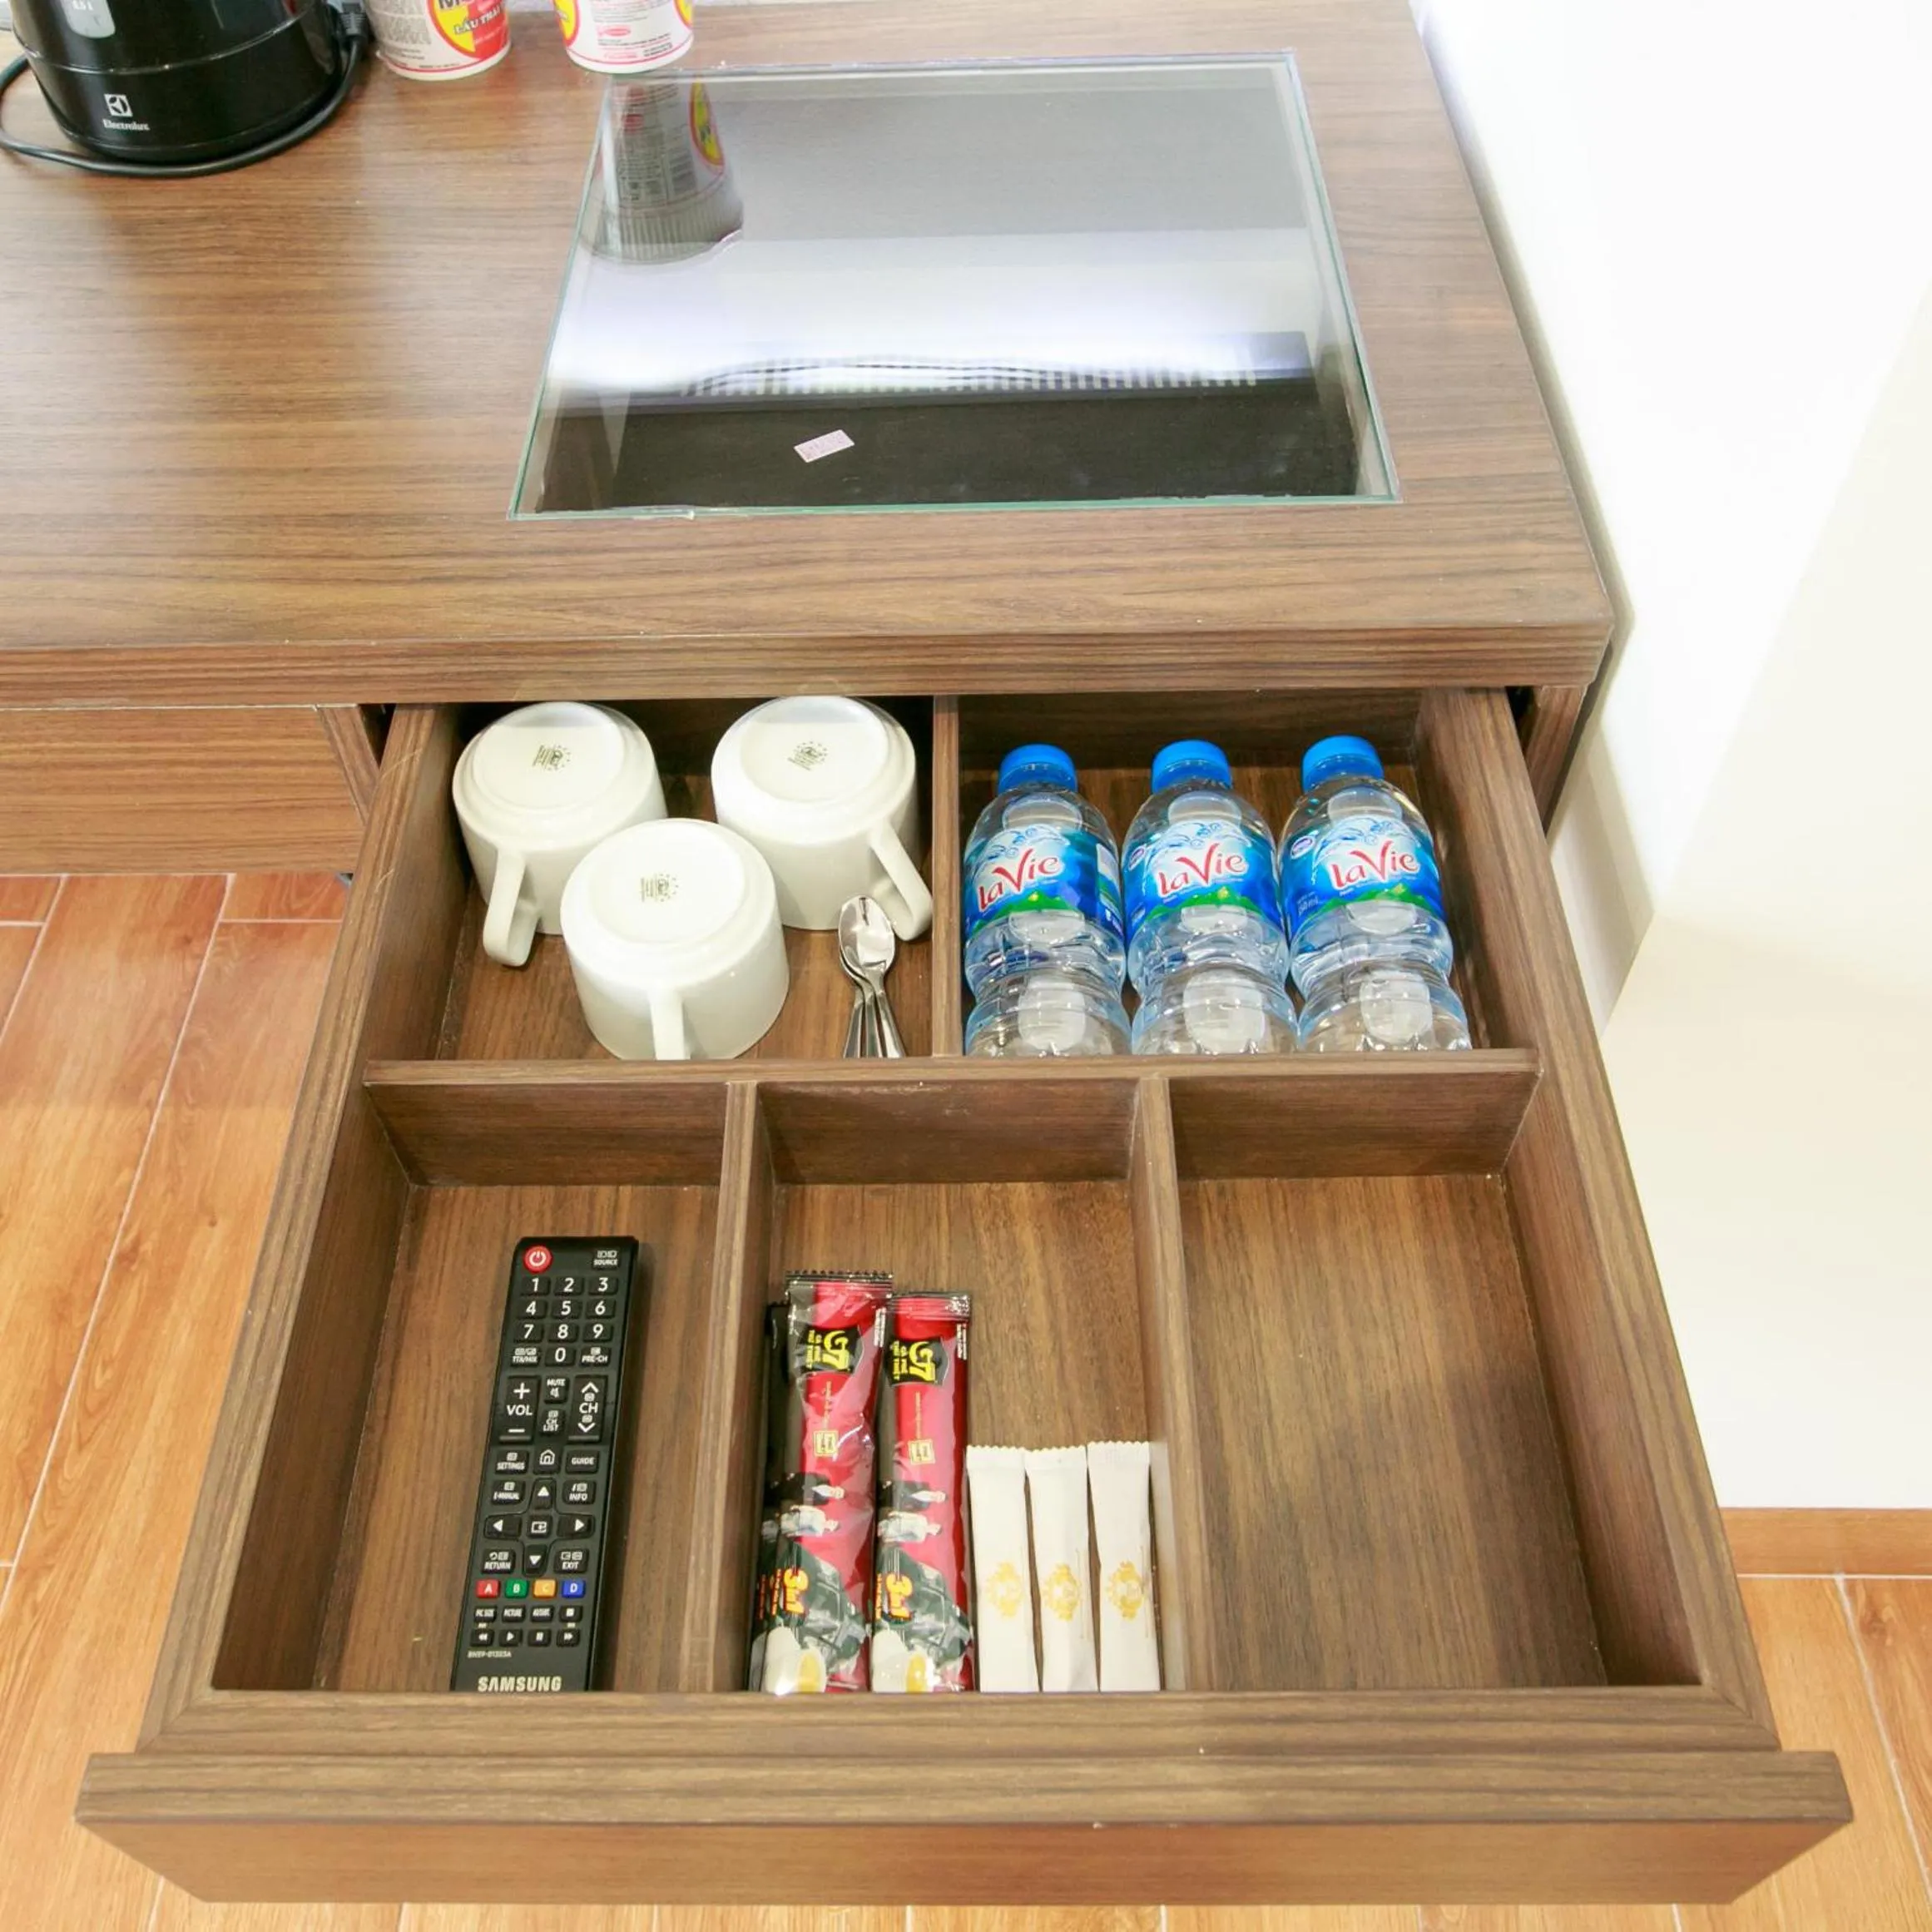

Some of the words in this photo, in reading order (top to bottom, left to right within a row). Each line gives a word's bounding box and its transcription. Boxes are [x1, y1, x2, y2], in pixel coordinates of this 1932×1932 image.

[103, 119, 151, 131] Electrolux
[532, 1278, 539, 1291] 1
[563, 1278, 574, 1291] 2
[598, 1278, 608, 1291] 3
[525, 1301, 537, 1315] 4
[561, 1301, 572, 1315] 5
[595, 1301, 606, 1315] 6
[524, 1324, 534, 1339] 7
[557, 1324, 568, 1339] 8
[592, 1324, 603, 1339] 9
[555, 1347, 566, 1363] 0
[824, 1330, 850, 1370] G7
[909, 1341, 936, 1381] G7
[547, 1379, 566, 1387] MUTE
[507, 1404, 533, 1415] VOL
[579, 1403, 598, 1414] CH
[497, 1462, 525, 1470] SETTINGS
[572, 1457, 595, 1465] GUIDE
[484, 1562, 511, 1570] RETURN
[562, 1562, 578, 1570] EXIT
[484, 1584, 493, 1593] A
[513, 1584, 520, 1593] B
[542, 1584, 549, 1593] C
[570, 1584, 577, 1593] D
[478, 1676, 562, 1692] SAMSUNG
